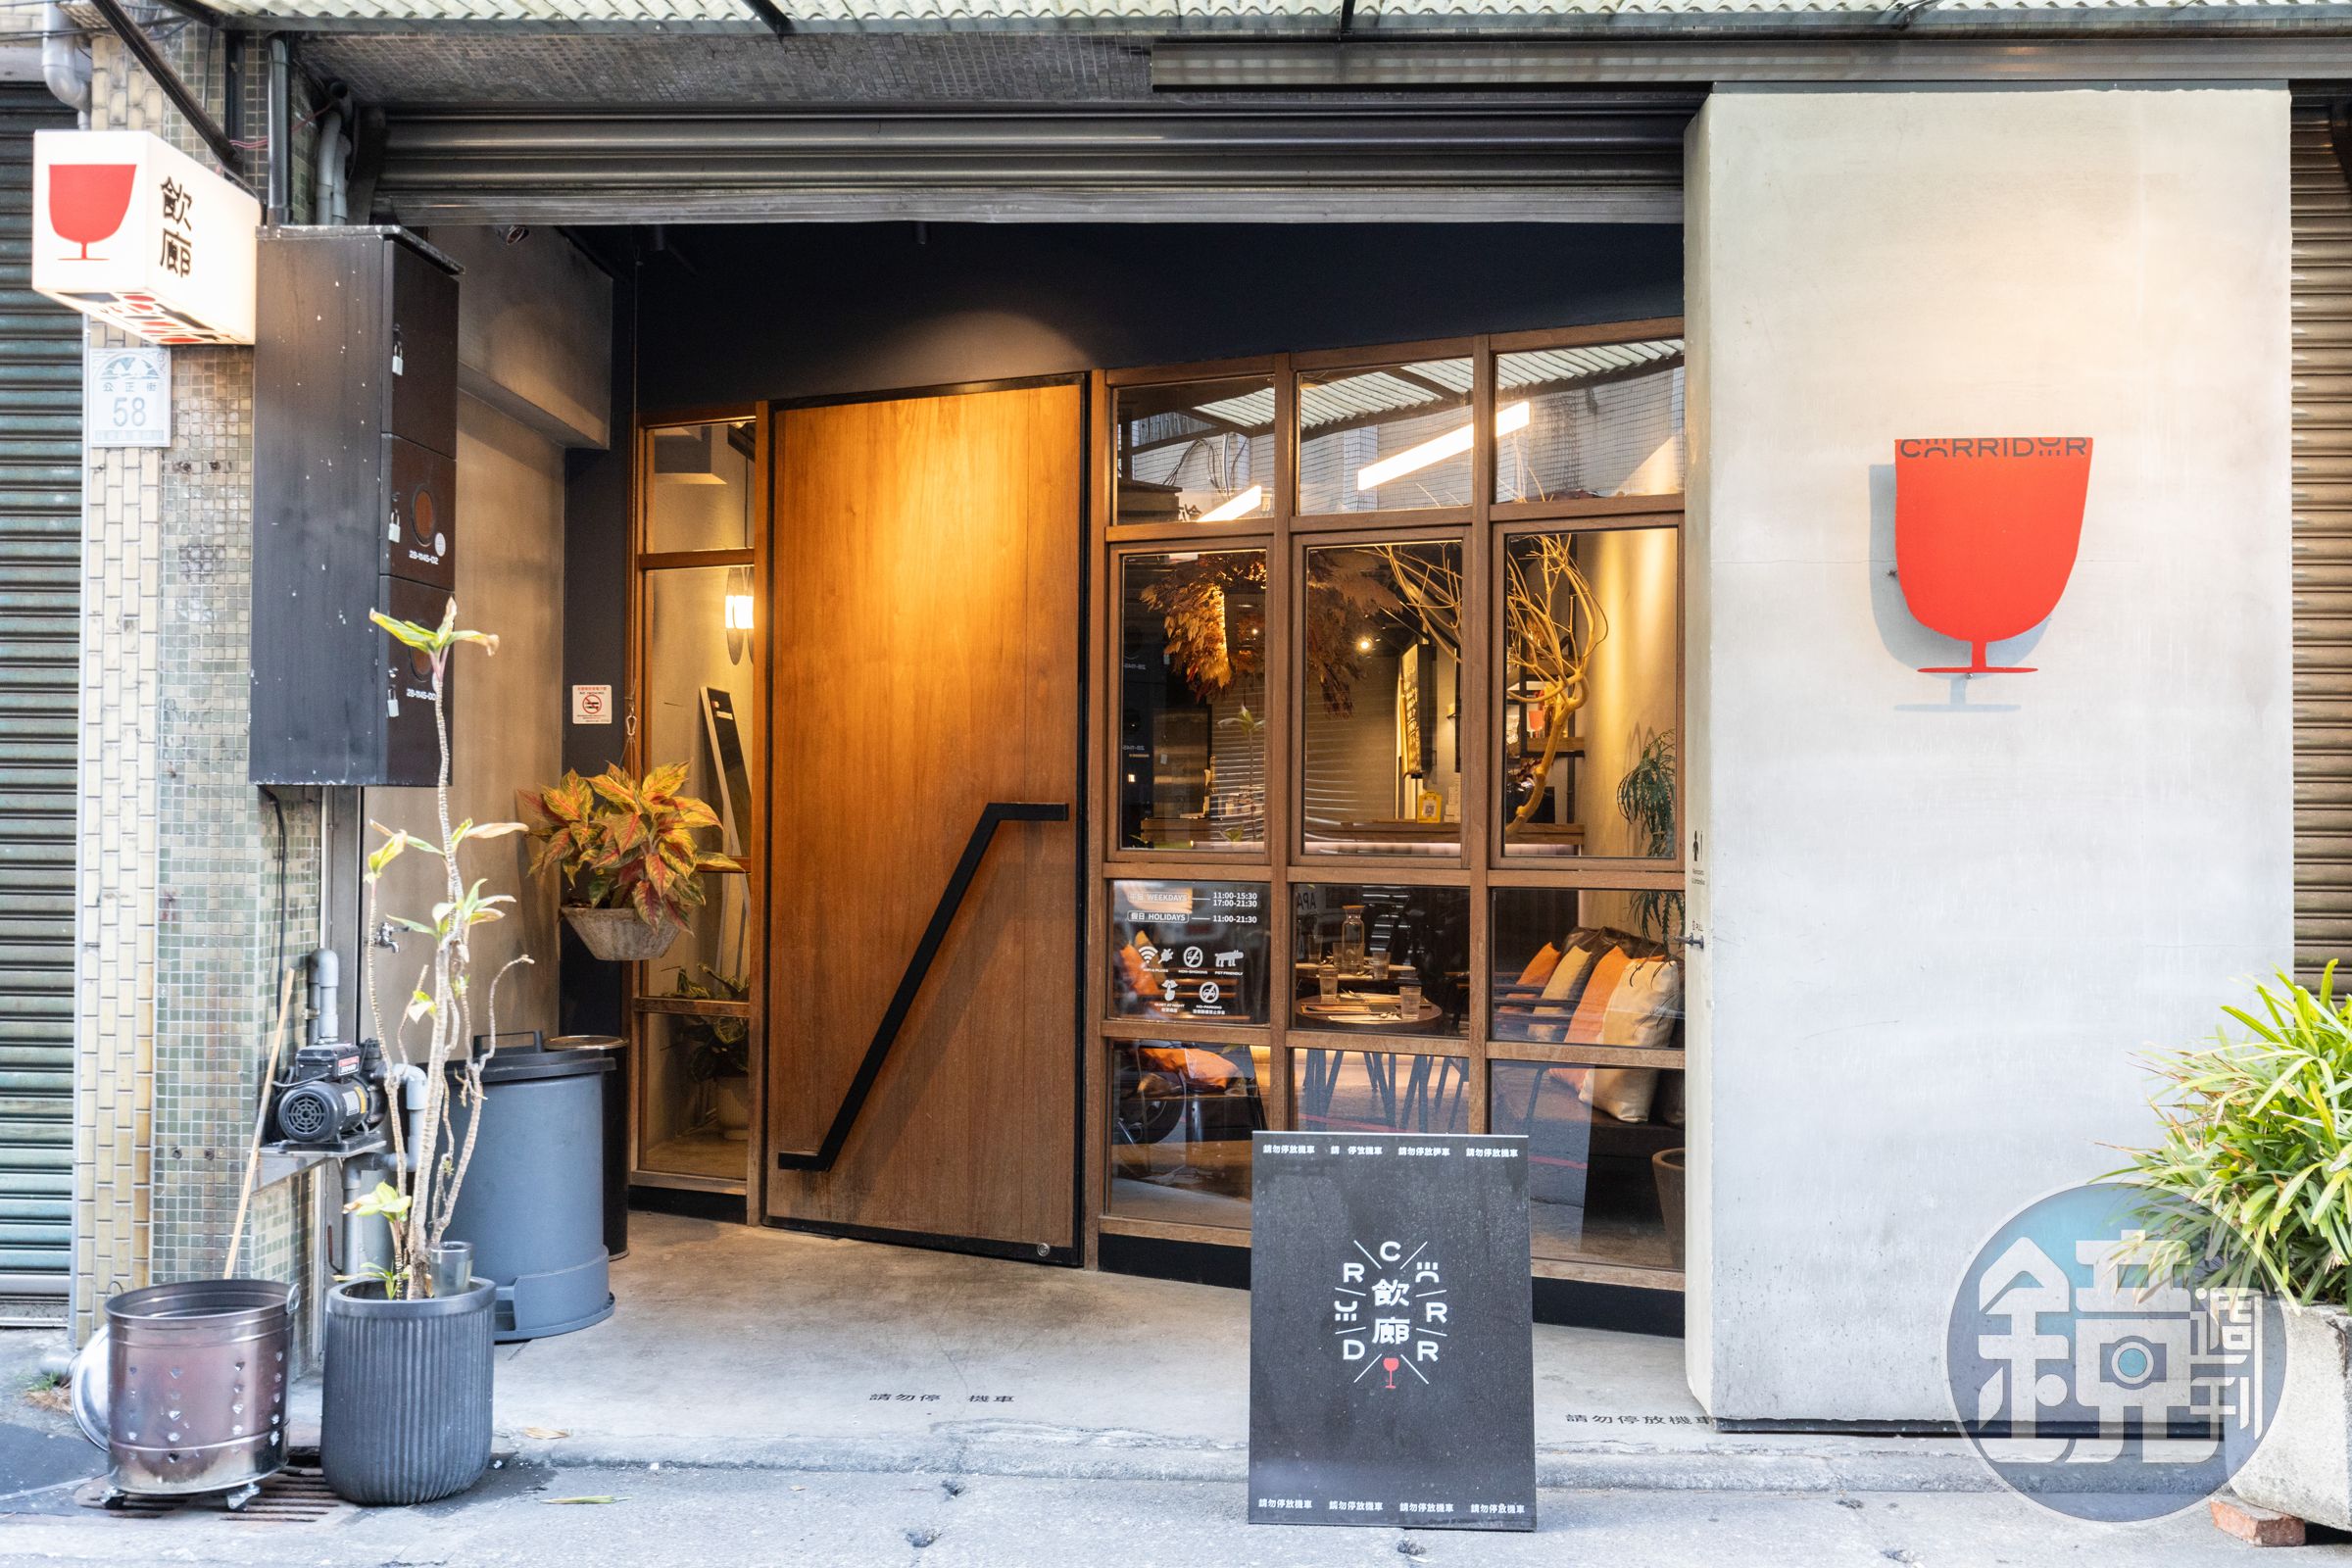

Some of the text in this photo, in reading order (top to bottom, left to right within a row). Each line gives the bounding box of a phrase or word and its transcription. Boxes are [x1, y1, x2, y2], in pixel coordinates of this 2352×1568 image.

[160, 175, 193, 278] 飲廊
[113, 397, 146, 427] 58
[1147, 893, 1188, 902] WEEKDAYS
[1212, 891, 1257, 901] 11:00-15:30
[1212, 899, 1257, 908] 17:00-21:30
[1131, 911, 1257, 924] 假日 HOLIDAYS 11:00-21:30
[1465, 1147, 1519, 1158] 請勿停放機車
[1258, 1498, 1525, 1515] 請勿停放機車 請勿停放機車 請勿停放機車 請勿停放機車
